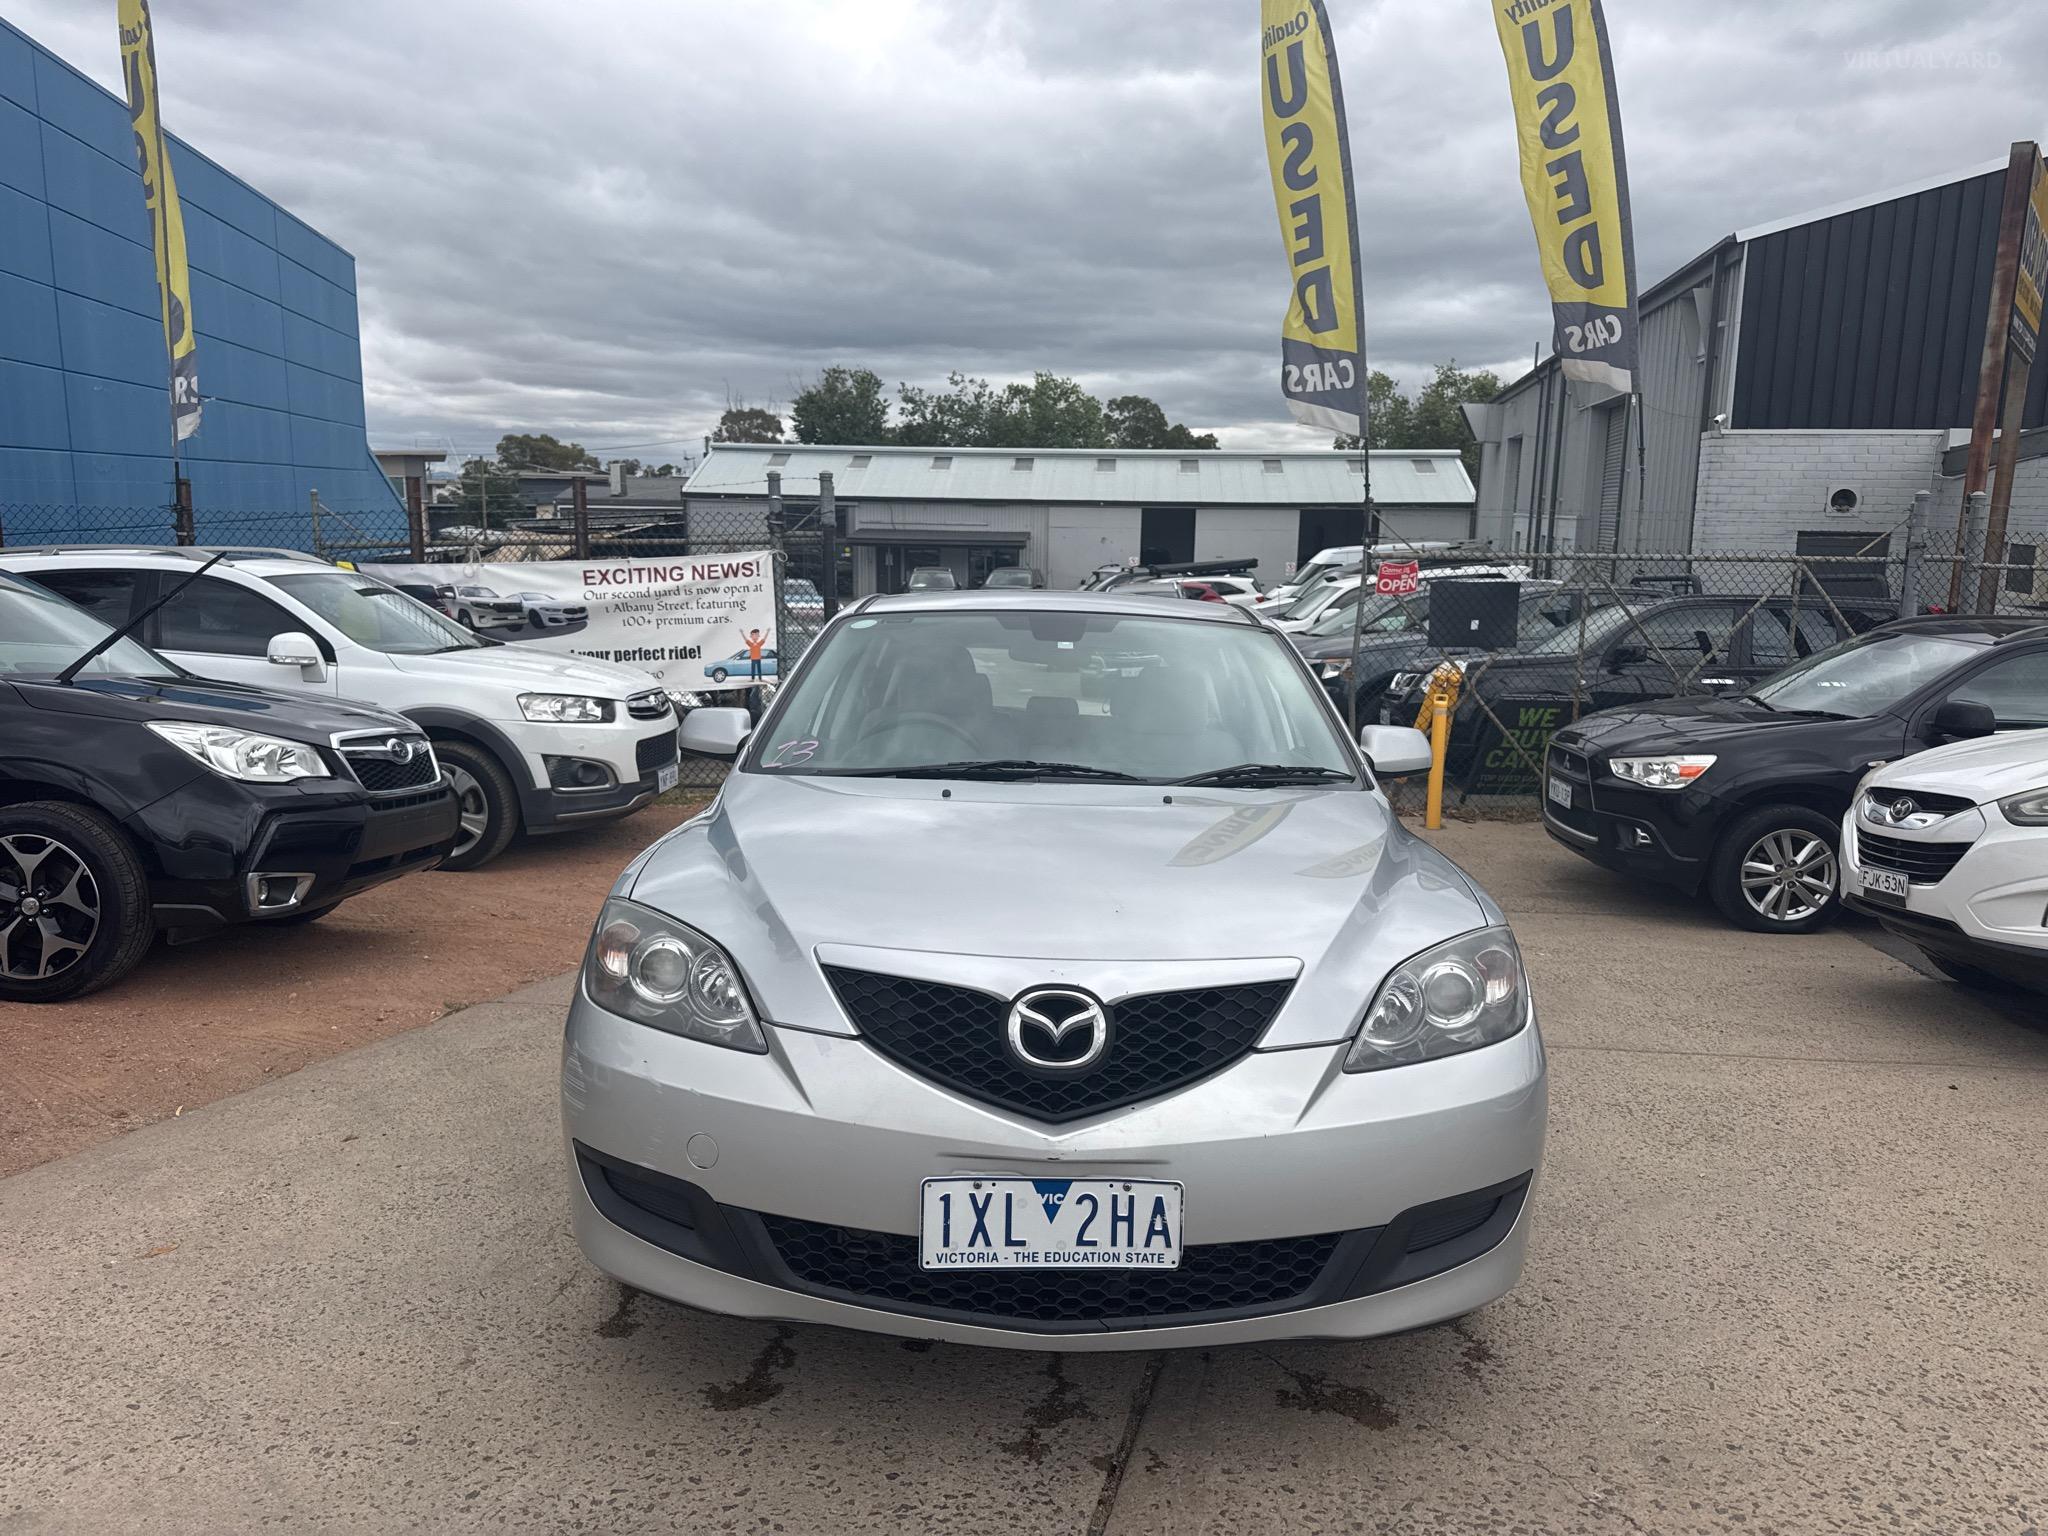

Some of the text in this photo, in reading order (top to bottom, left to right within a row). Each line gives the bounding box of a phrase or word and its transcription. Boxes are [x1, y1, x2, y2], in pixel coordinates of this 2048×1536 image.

[583, 561, 761, 586] EXCITING NEWS!
[583, 583, 763, 601] Our second yard is now open at
[1379, 577, 1417, 591] OPEN
[613, 601, 654, 615] Albany
[696, 597, 747, 611] featuring
[622, 613, 733, 629] 100+ premium cars.
[614, 647, 666, 662] perfect
[669, 645, 701, 660] ride!
[1519, 708, 1560, 727] WE
[1037, 1193, 1064, 1205] VIC
[939, 1192, 1172, 1249] 1XL 2HA
[936, 1252, 999, 1264] VICTORIA
[1013, 1251, 1040, 1263] THE
[1044, 1252, 1121, 1263] EDUCATION
[1125, 1253, 1165, 1264] STATE
